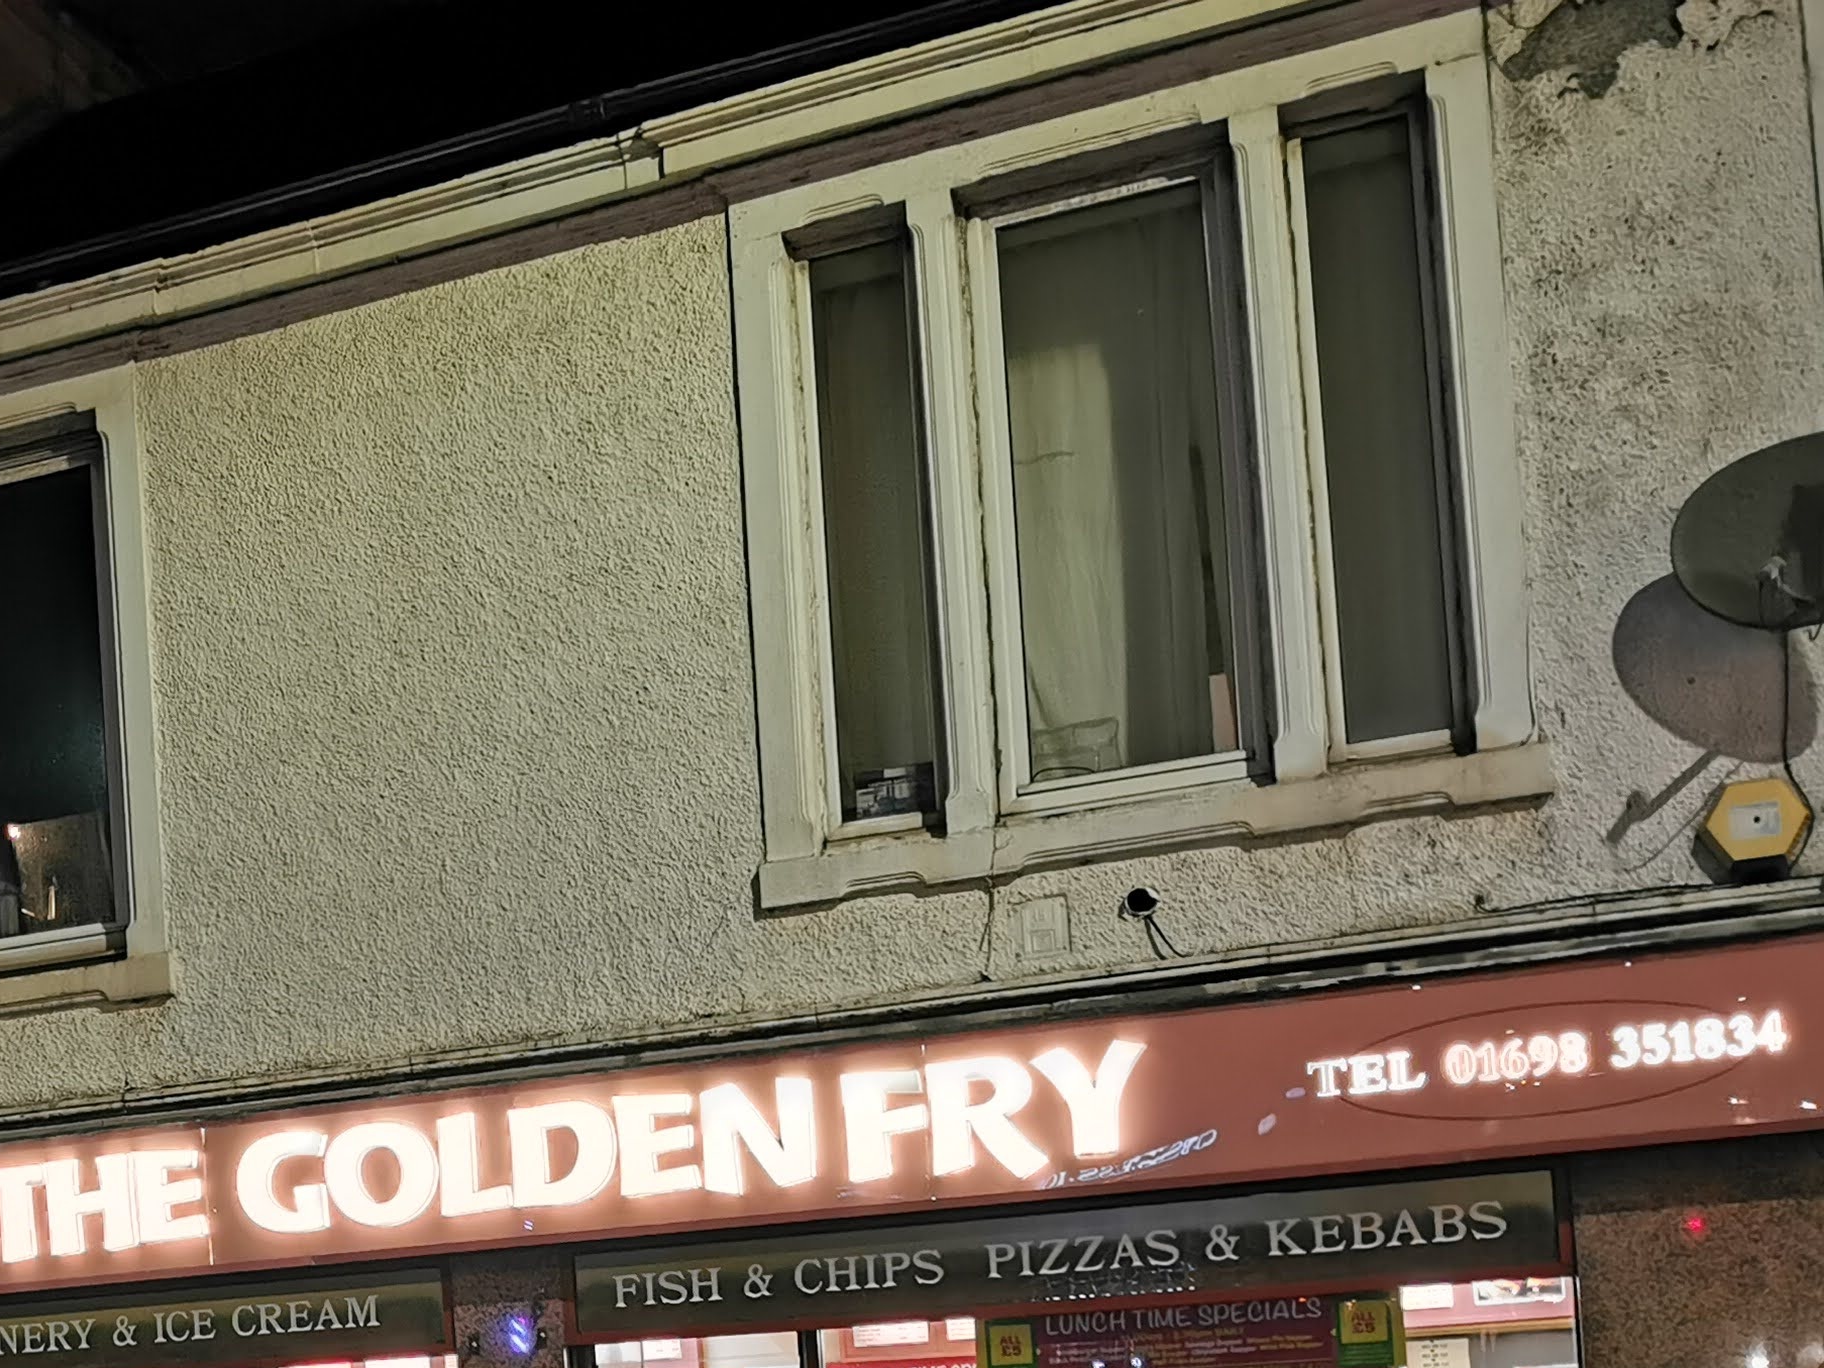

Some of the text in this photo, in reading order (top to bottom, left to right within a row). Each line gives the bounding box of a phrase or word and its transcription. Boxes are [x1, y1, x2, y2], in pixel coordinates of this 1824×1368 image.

[1307, 1010, 1787, 1098] TEL 01698 351834
[236, 1076, 818, 1234] GOLDEN
[838, 1039, 1148, 1183] FRY
[613, 1200, 1508, 1308] FISH & CHIPS PIZZAS & KEBABS
[112, 1315, 137, 1347] &
[154, 1308, 216, 1344] ICE
[231, 1295, 381, 1337] CREAM
[1045, 1297, 1322, 1336] LUNCH TIME SPECIALS
